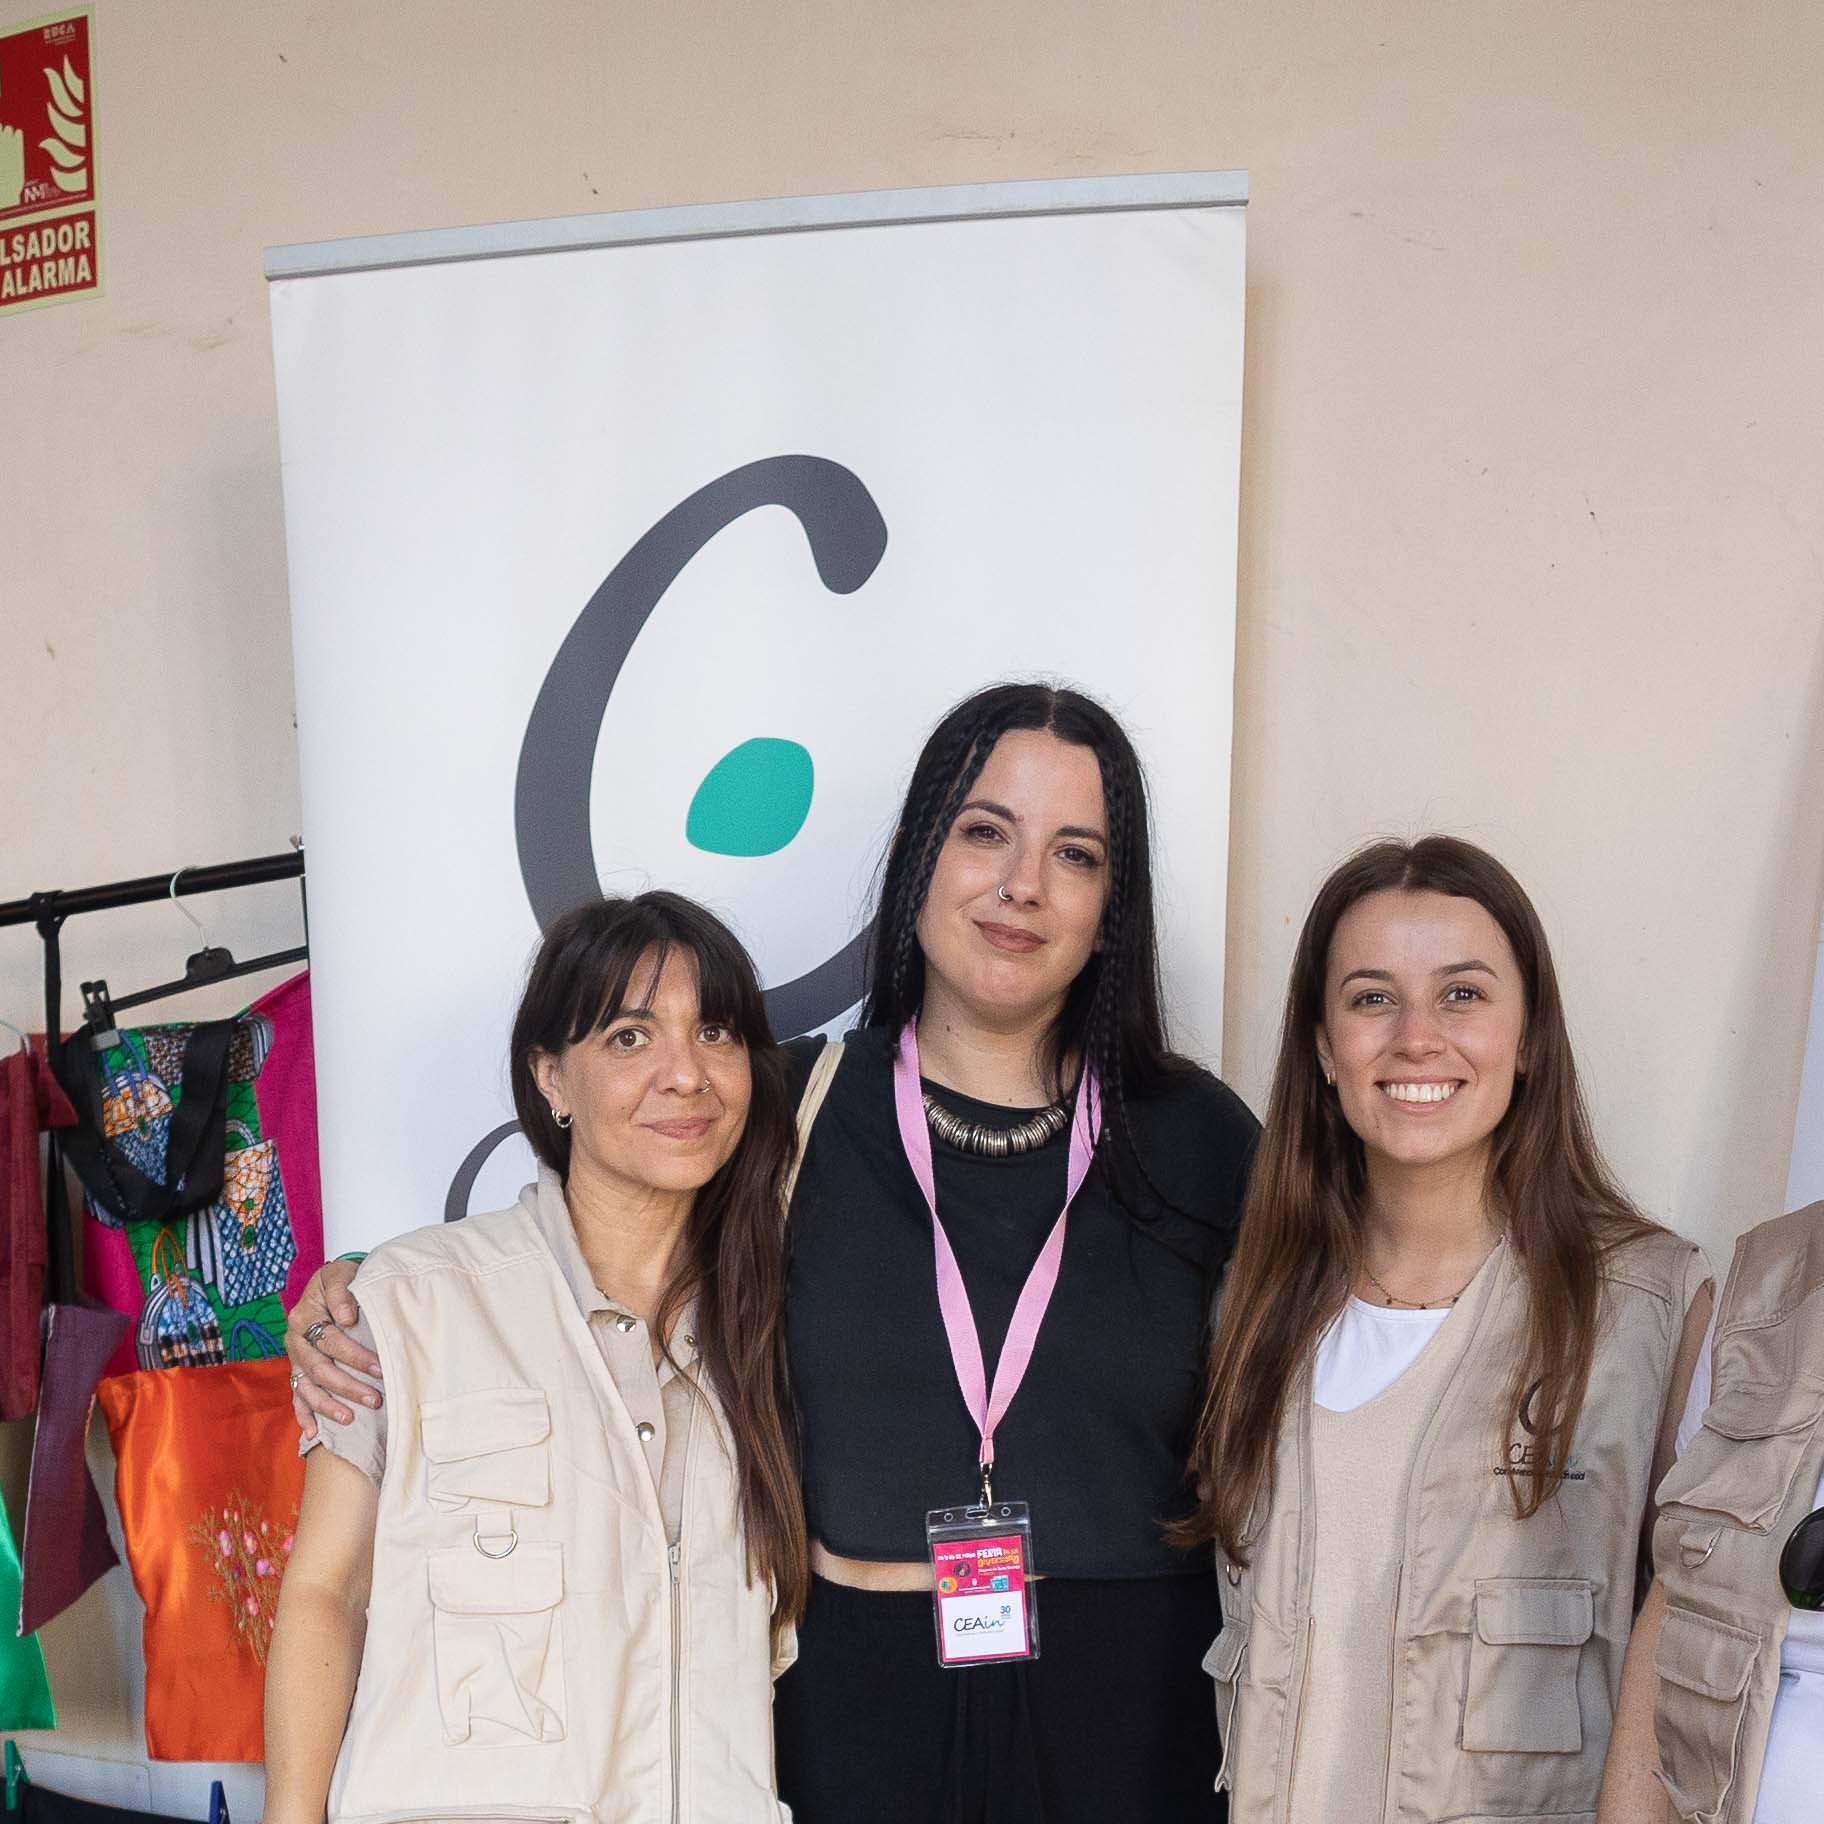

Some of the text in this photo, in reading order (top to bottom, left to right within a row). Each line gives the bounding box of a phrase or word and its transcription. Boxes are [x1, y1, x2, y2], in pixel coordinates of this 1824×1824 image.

[2, 259, 93, 298] ALARMA
[1000, 1605, 1011, 1614] 30
[954, 1616, 1005, 1632] CEAin
